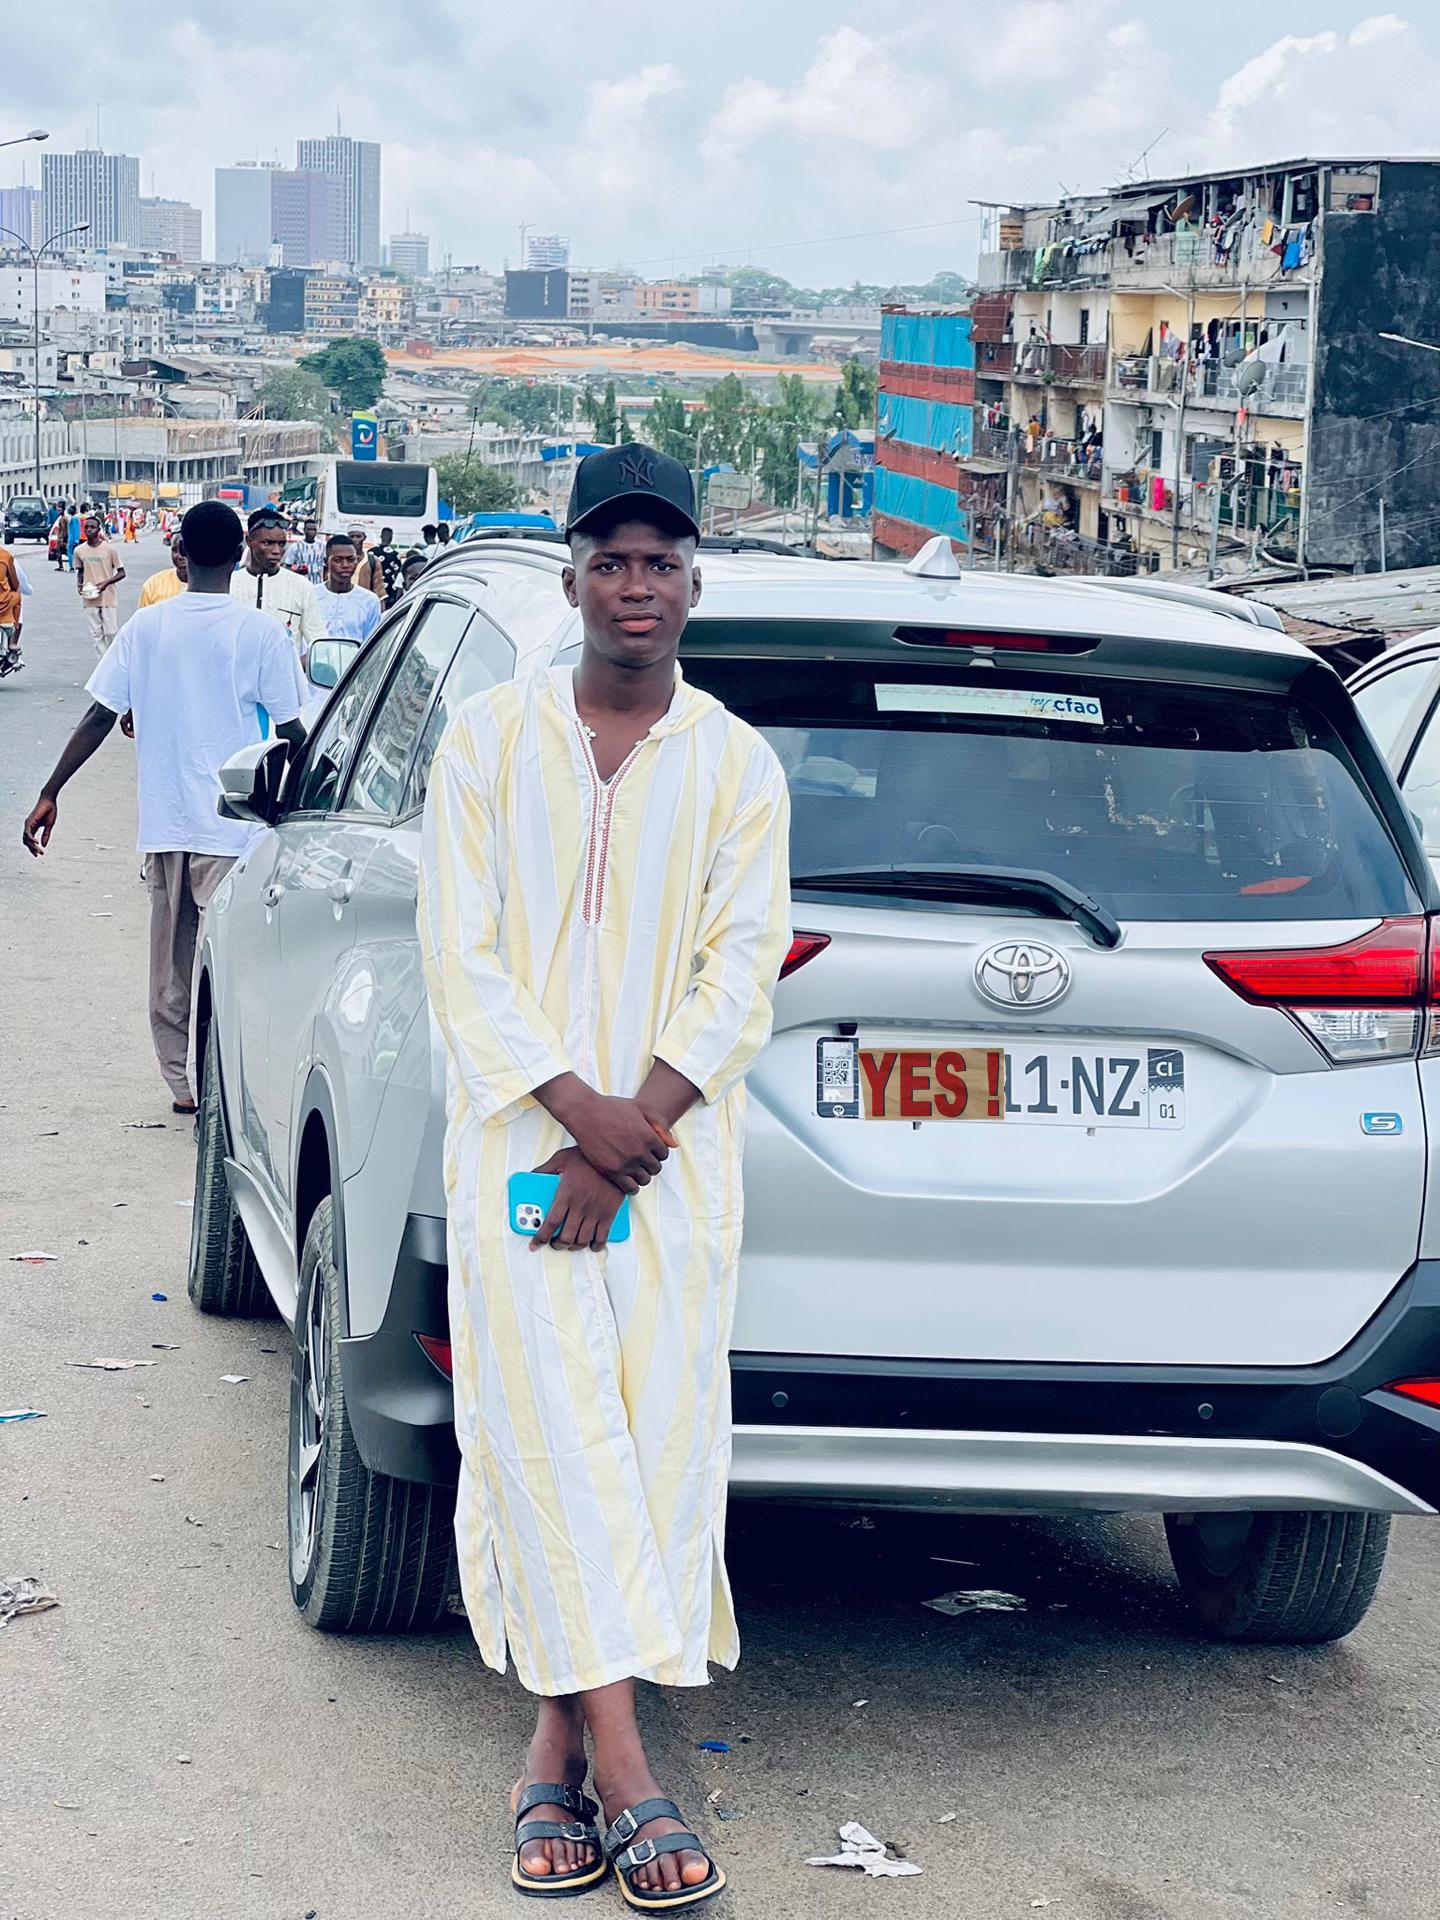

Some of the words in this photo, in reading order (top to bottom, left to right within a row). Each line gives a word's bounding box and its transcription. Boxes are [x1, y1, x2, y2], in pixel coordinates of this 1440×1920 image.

[619, 454, 655, 488] NY
[1053, 697, 1099, 715] cfao
[1156, 1061, 1173, 1077] CI
[1159, 1103, 1177, 1119] 01
